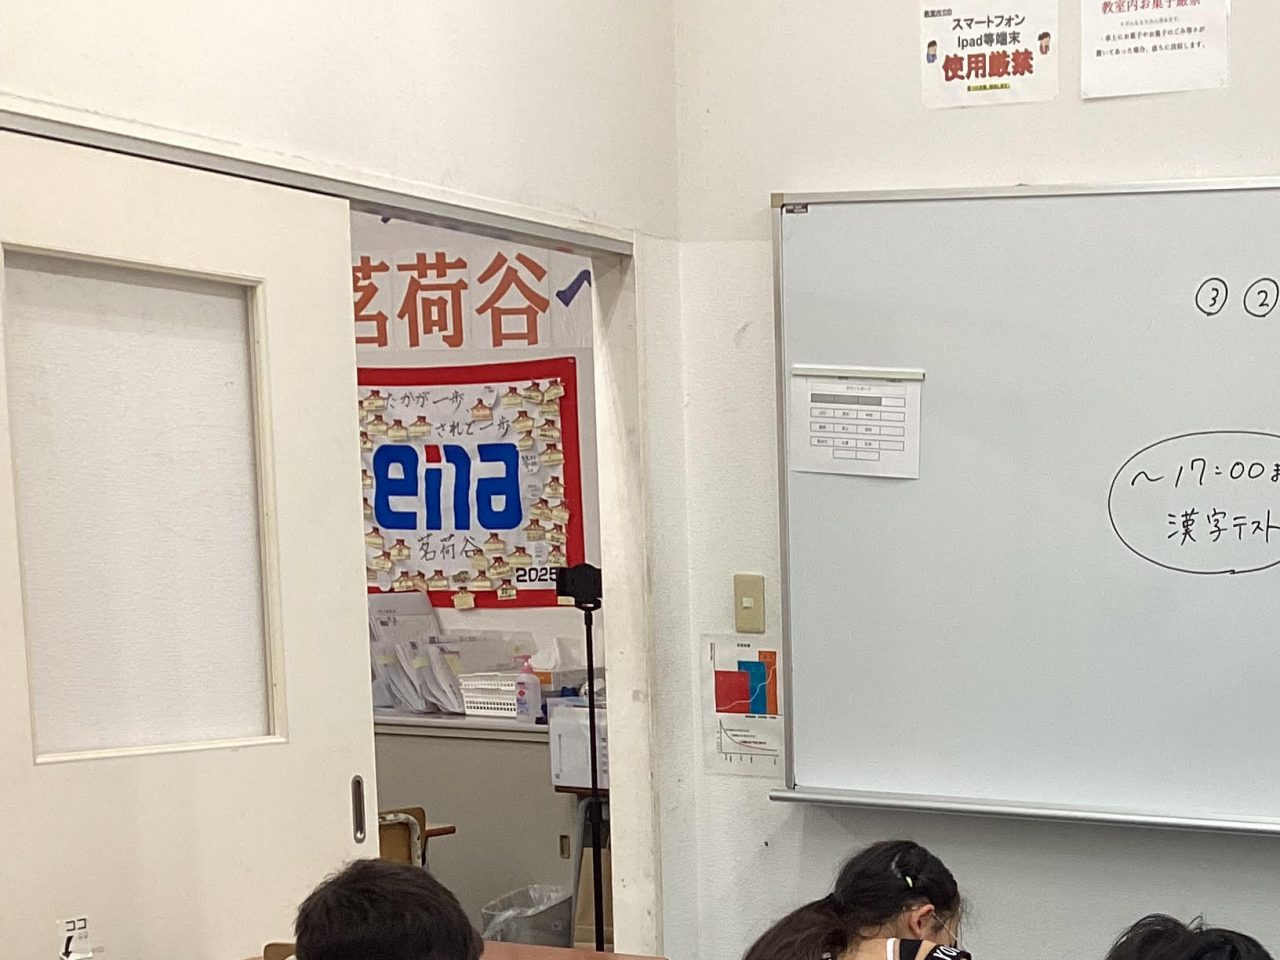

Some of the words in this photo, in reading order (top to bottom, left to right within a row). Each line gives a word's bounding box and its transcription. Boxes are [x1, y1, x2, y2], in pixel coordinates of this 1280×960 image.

[952, 14, 1026, 30] スマートフォン
[942, 48, 1034, 81] 使用厳禁
[373, 443, 523, 531] ena
[515, 567, 557, 583] 2025
